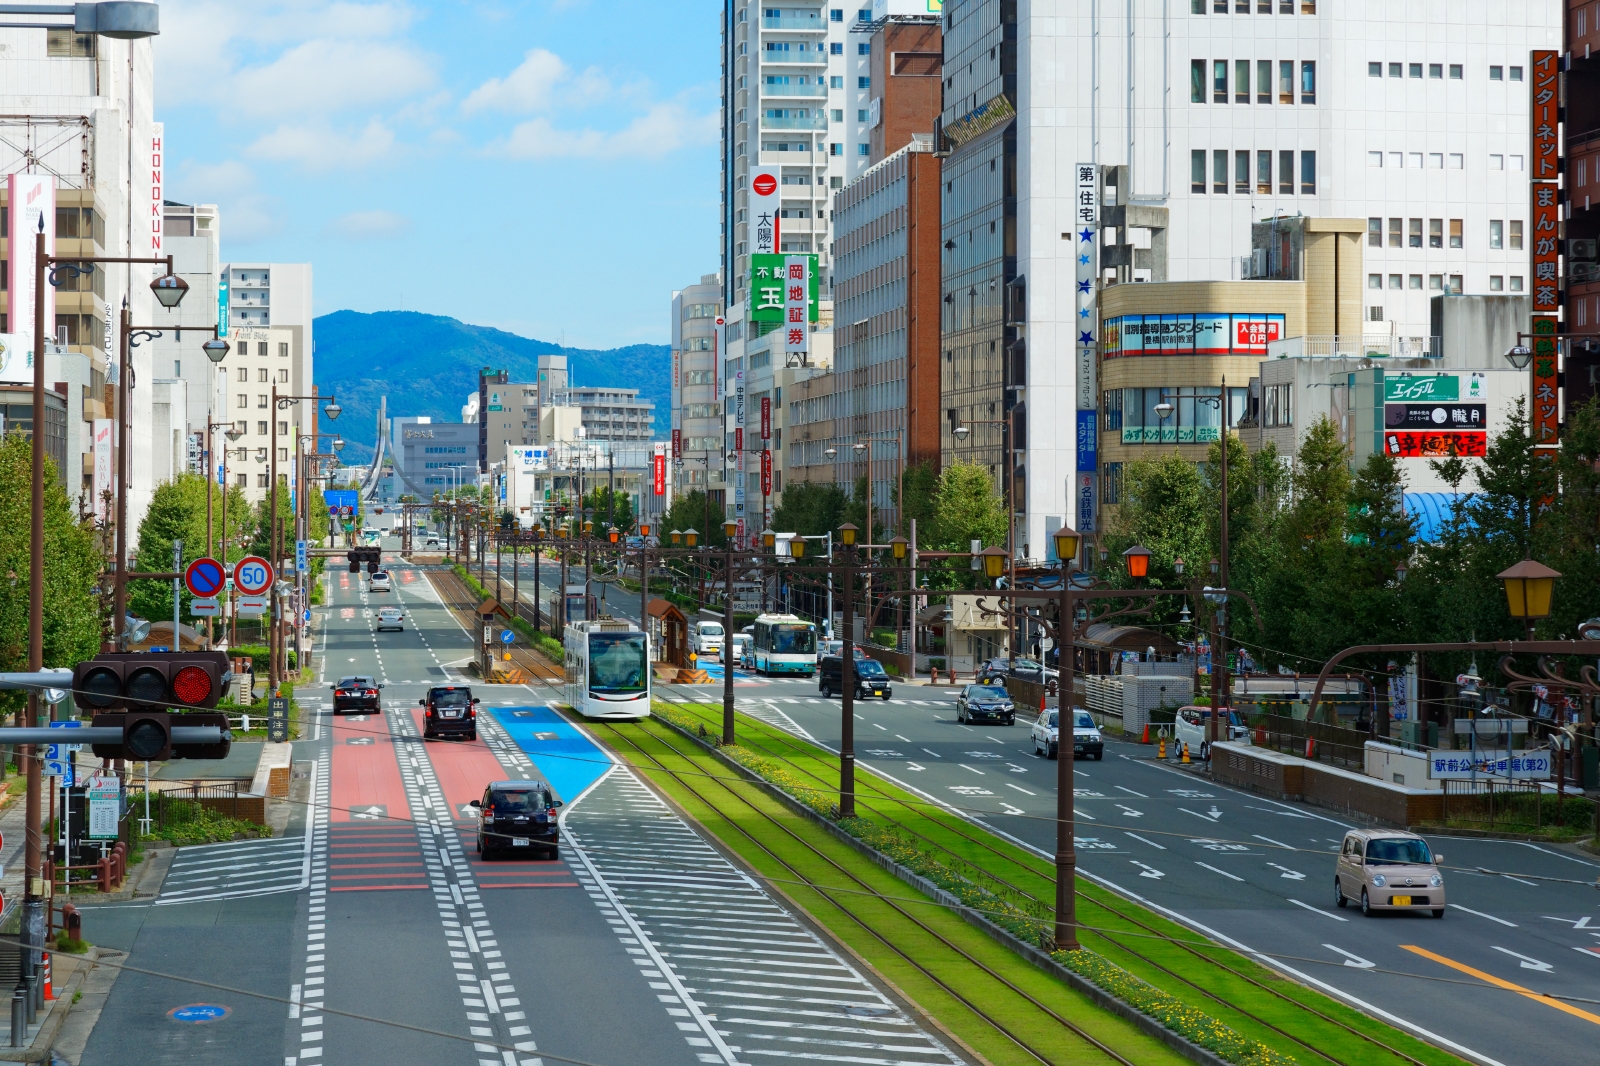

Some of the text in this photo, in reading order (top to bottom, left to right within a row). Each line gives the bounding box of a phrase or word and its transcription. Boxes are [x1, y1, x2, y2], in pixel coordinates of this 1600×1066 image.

[1535, 54, 1556, 175] インターネット
[152, 138, 161, 265] HONOKUNI
[1079, 167, 1094, 222] 第一住宅
[1535, 188, 1556, 306] まんが喫茶
[788, 264, 804, 345] 岡地証券
[1124, 322, 1222, 336] 個別指導塾スタンダード
[1145, 336, 1194, 344] 豊橋駅前教室
[1240, 324, 1277, 333] 入会費用
[736, 386, 744, 424] 中京テレビ
[1388, 378, 1436, 399] エイブル
[1081, 487, 1092, 531] 名鉄観光
[242, 567, 265, 585] 50
